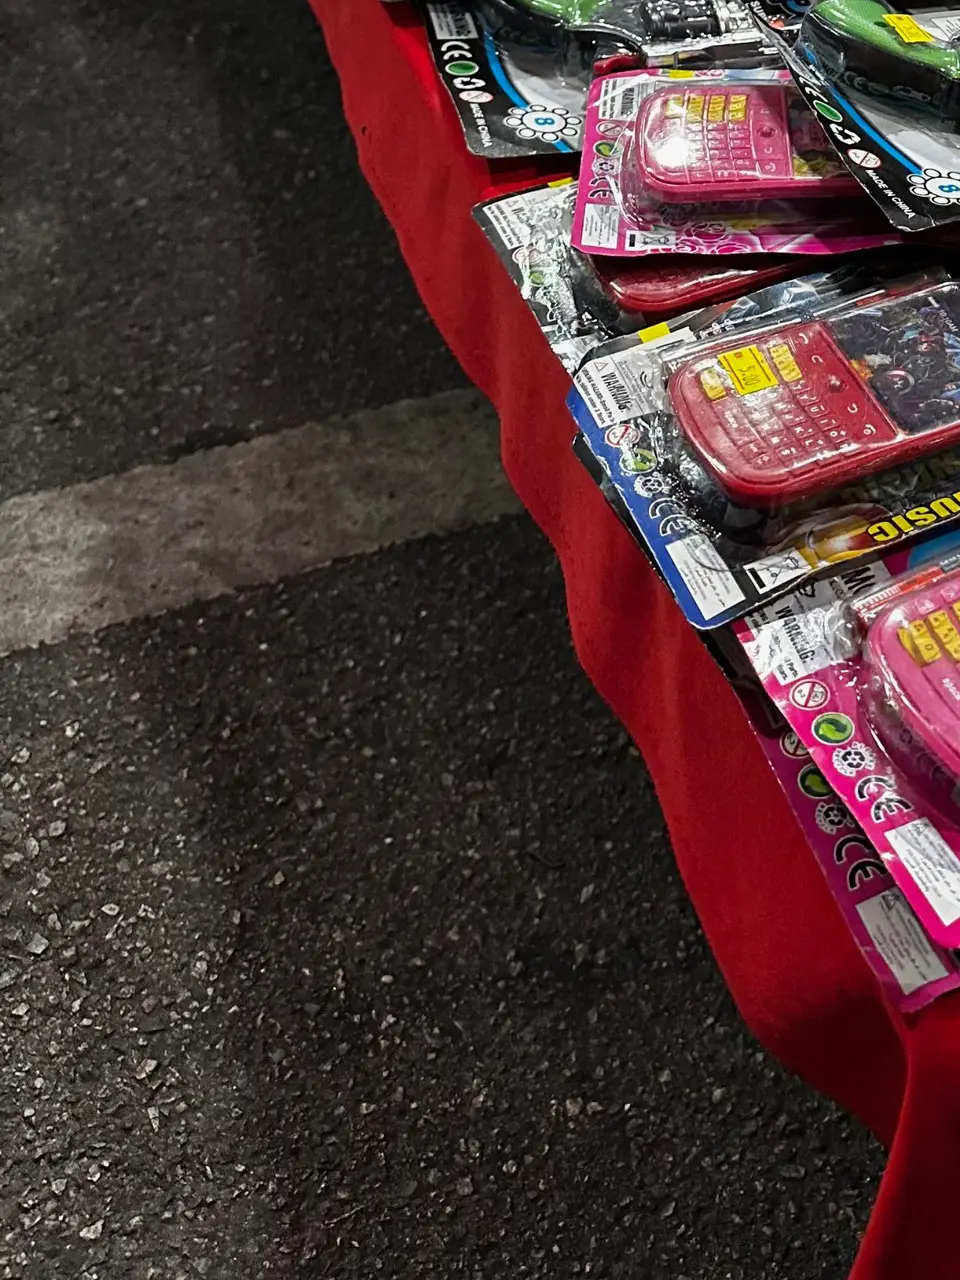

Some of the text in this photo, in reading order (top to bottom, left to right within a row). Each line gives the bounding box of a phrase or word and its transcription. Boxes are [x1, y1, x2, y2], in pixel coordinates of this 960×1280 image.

[535, 117, 555, 126] 8
[866, 169, 917, 219] MADE IN CHINA
[938, 184, 960, 194] 8
[855, 775, 913, 823] CE
[833, 834, 888, 891] CE
